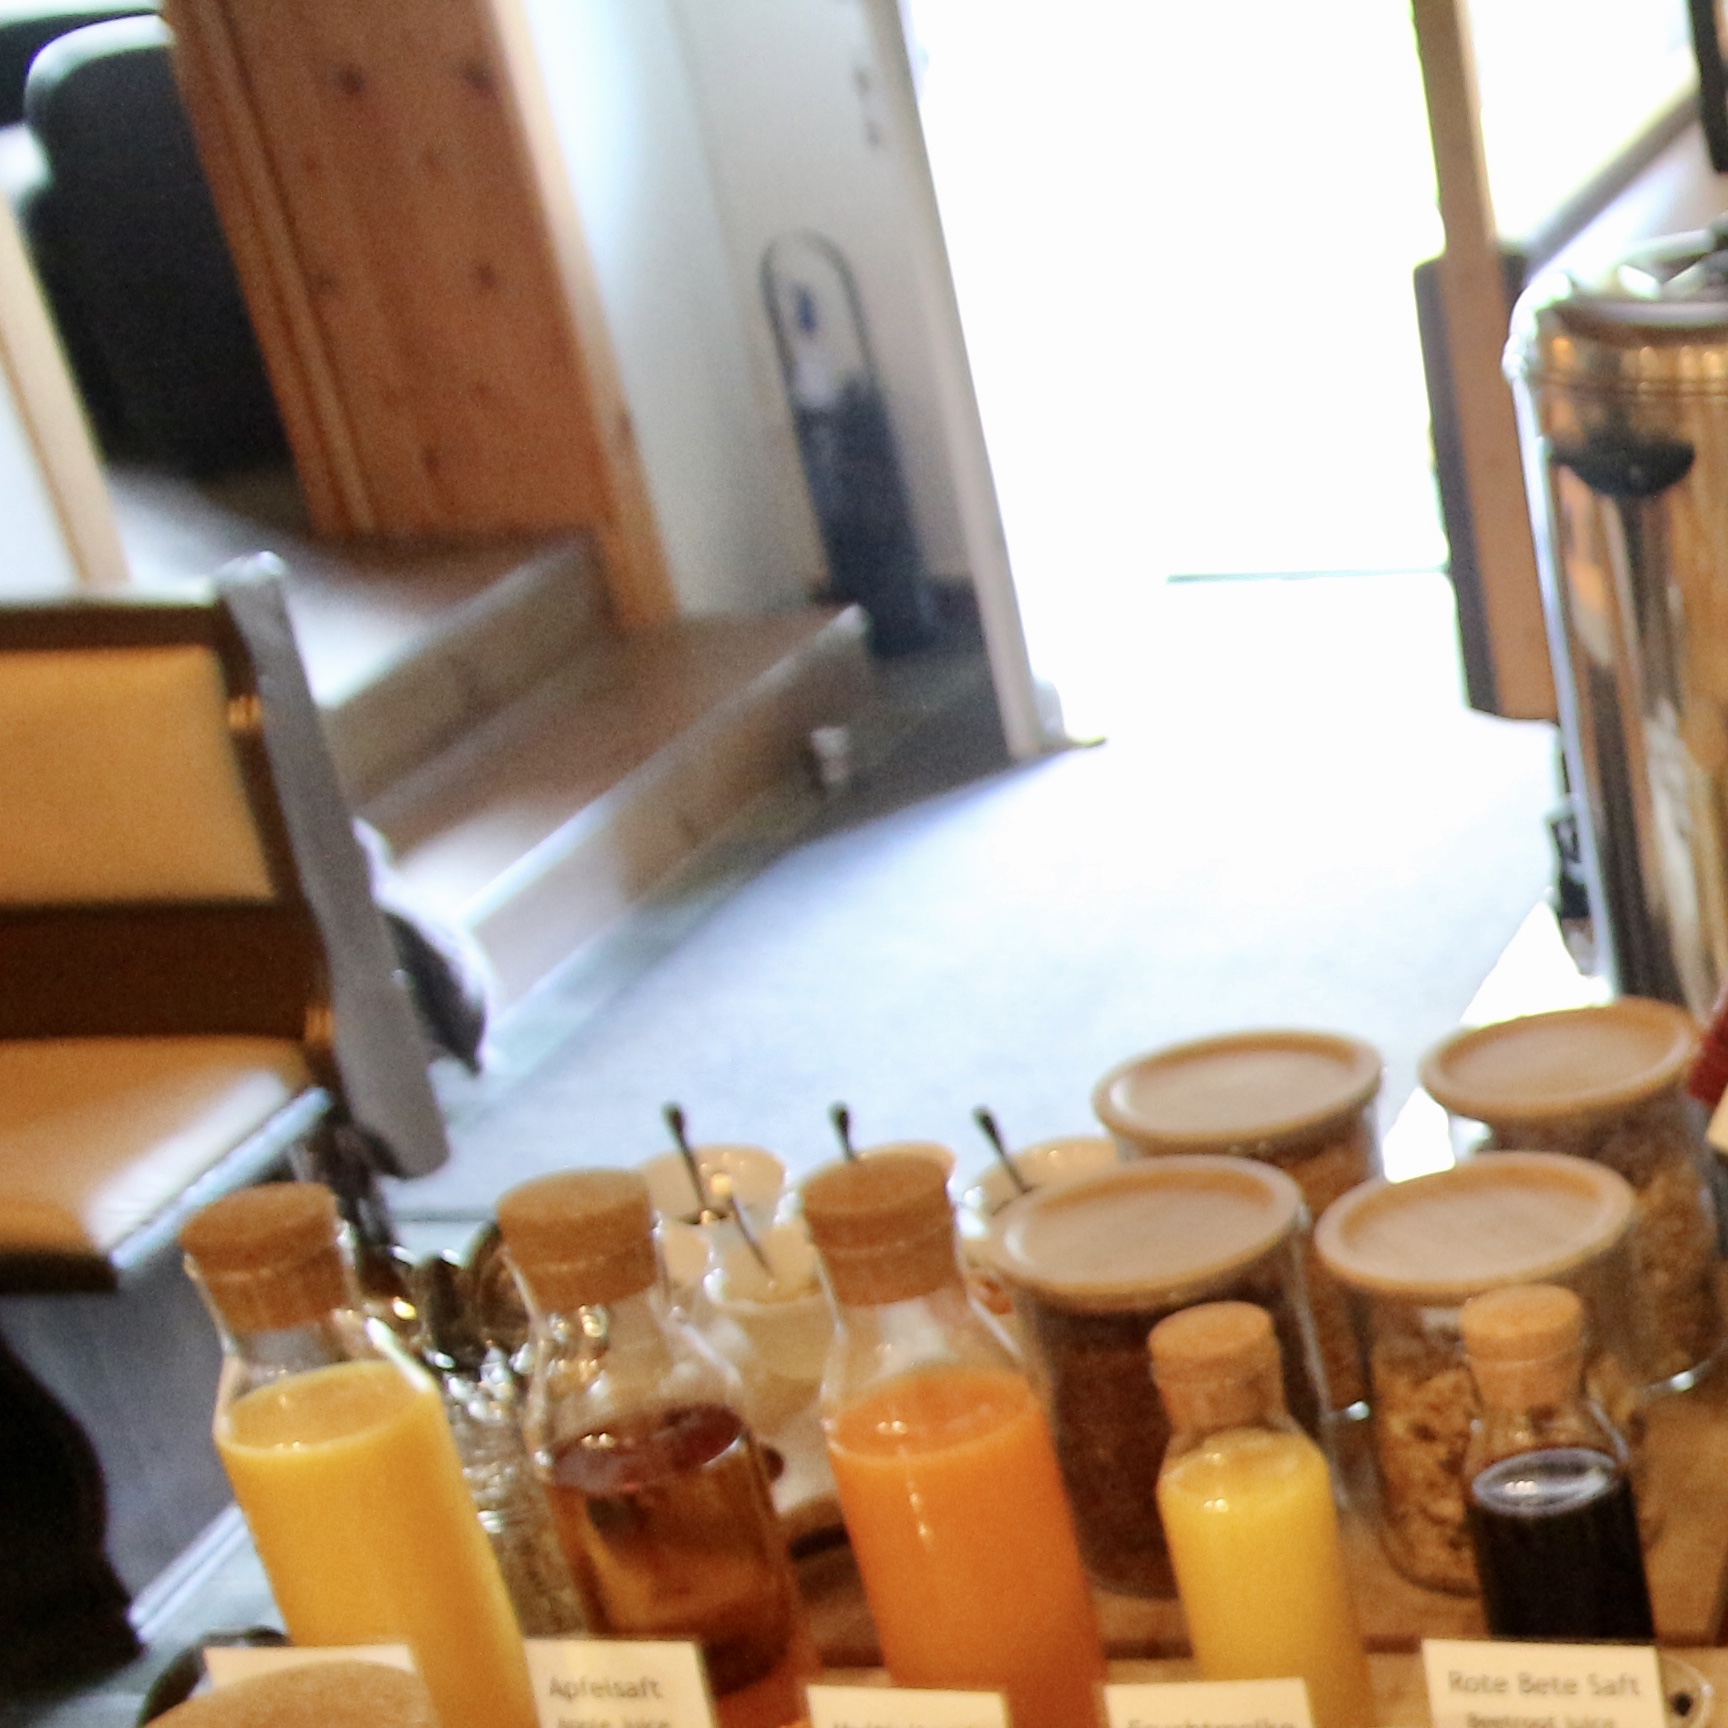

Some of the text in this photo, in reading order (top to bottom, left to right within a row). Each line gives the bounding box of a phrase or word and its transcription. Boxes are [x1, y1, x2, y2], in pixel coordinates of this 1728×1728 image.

[550, 1675, 663, 1702] Apfelsaft
[1449, 1669, 1641, 1696] Rote Bete Saft
